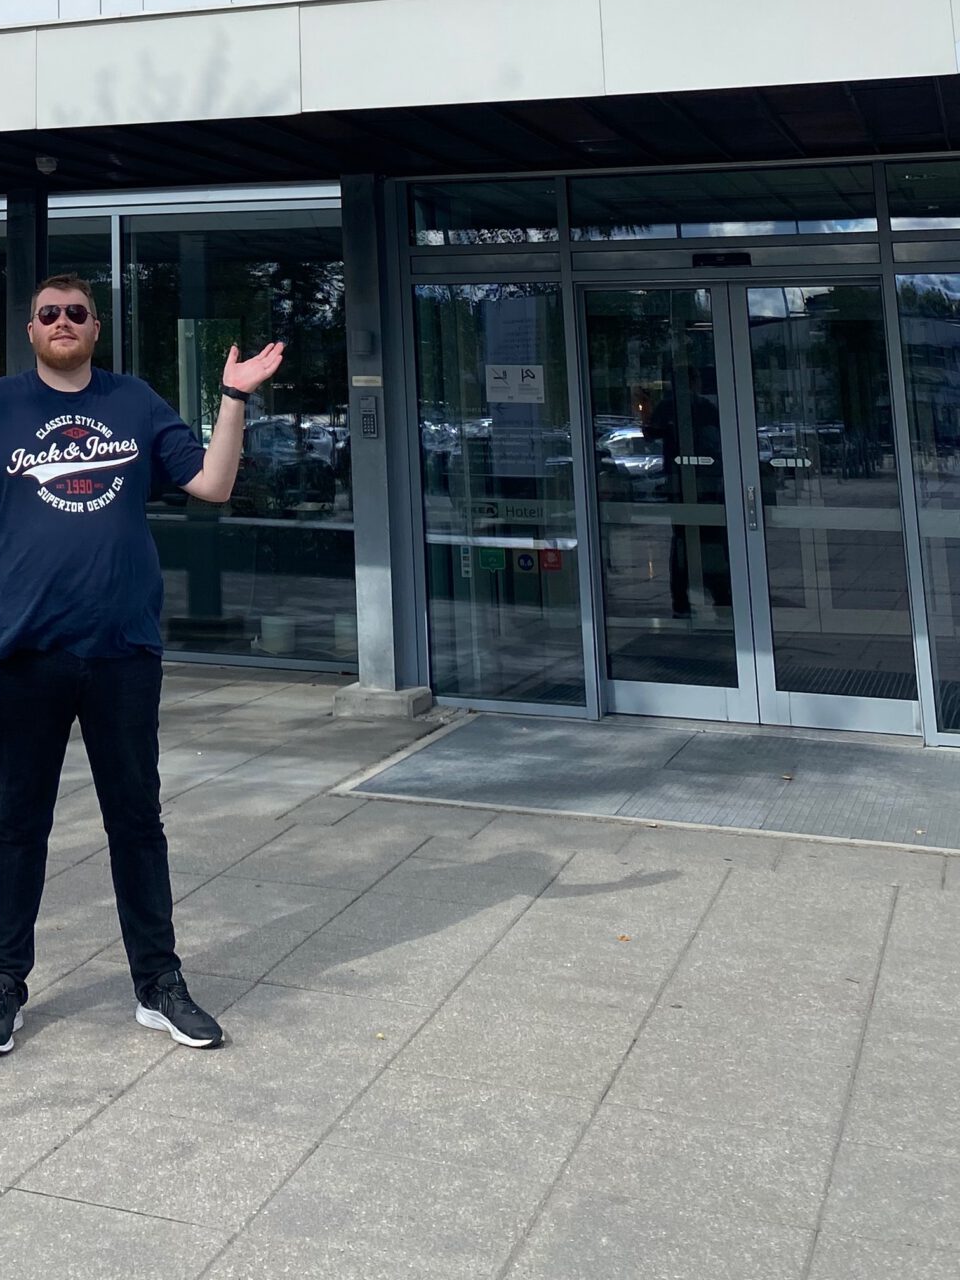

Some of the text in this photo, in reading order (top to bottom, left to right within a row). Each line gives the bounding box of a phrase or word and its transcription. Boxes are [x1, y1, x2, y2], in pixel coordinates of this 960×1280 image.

[35, 414, 113, 440] CLASSIC STYLING
[6, 435, 138, 474] Jack & Jones
[37, 475, 125, 513] SUPERIOR DENIM CO.
[66, 479, 93, 495] 1990
